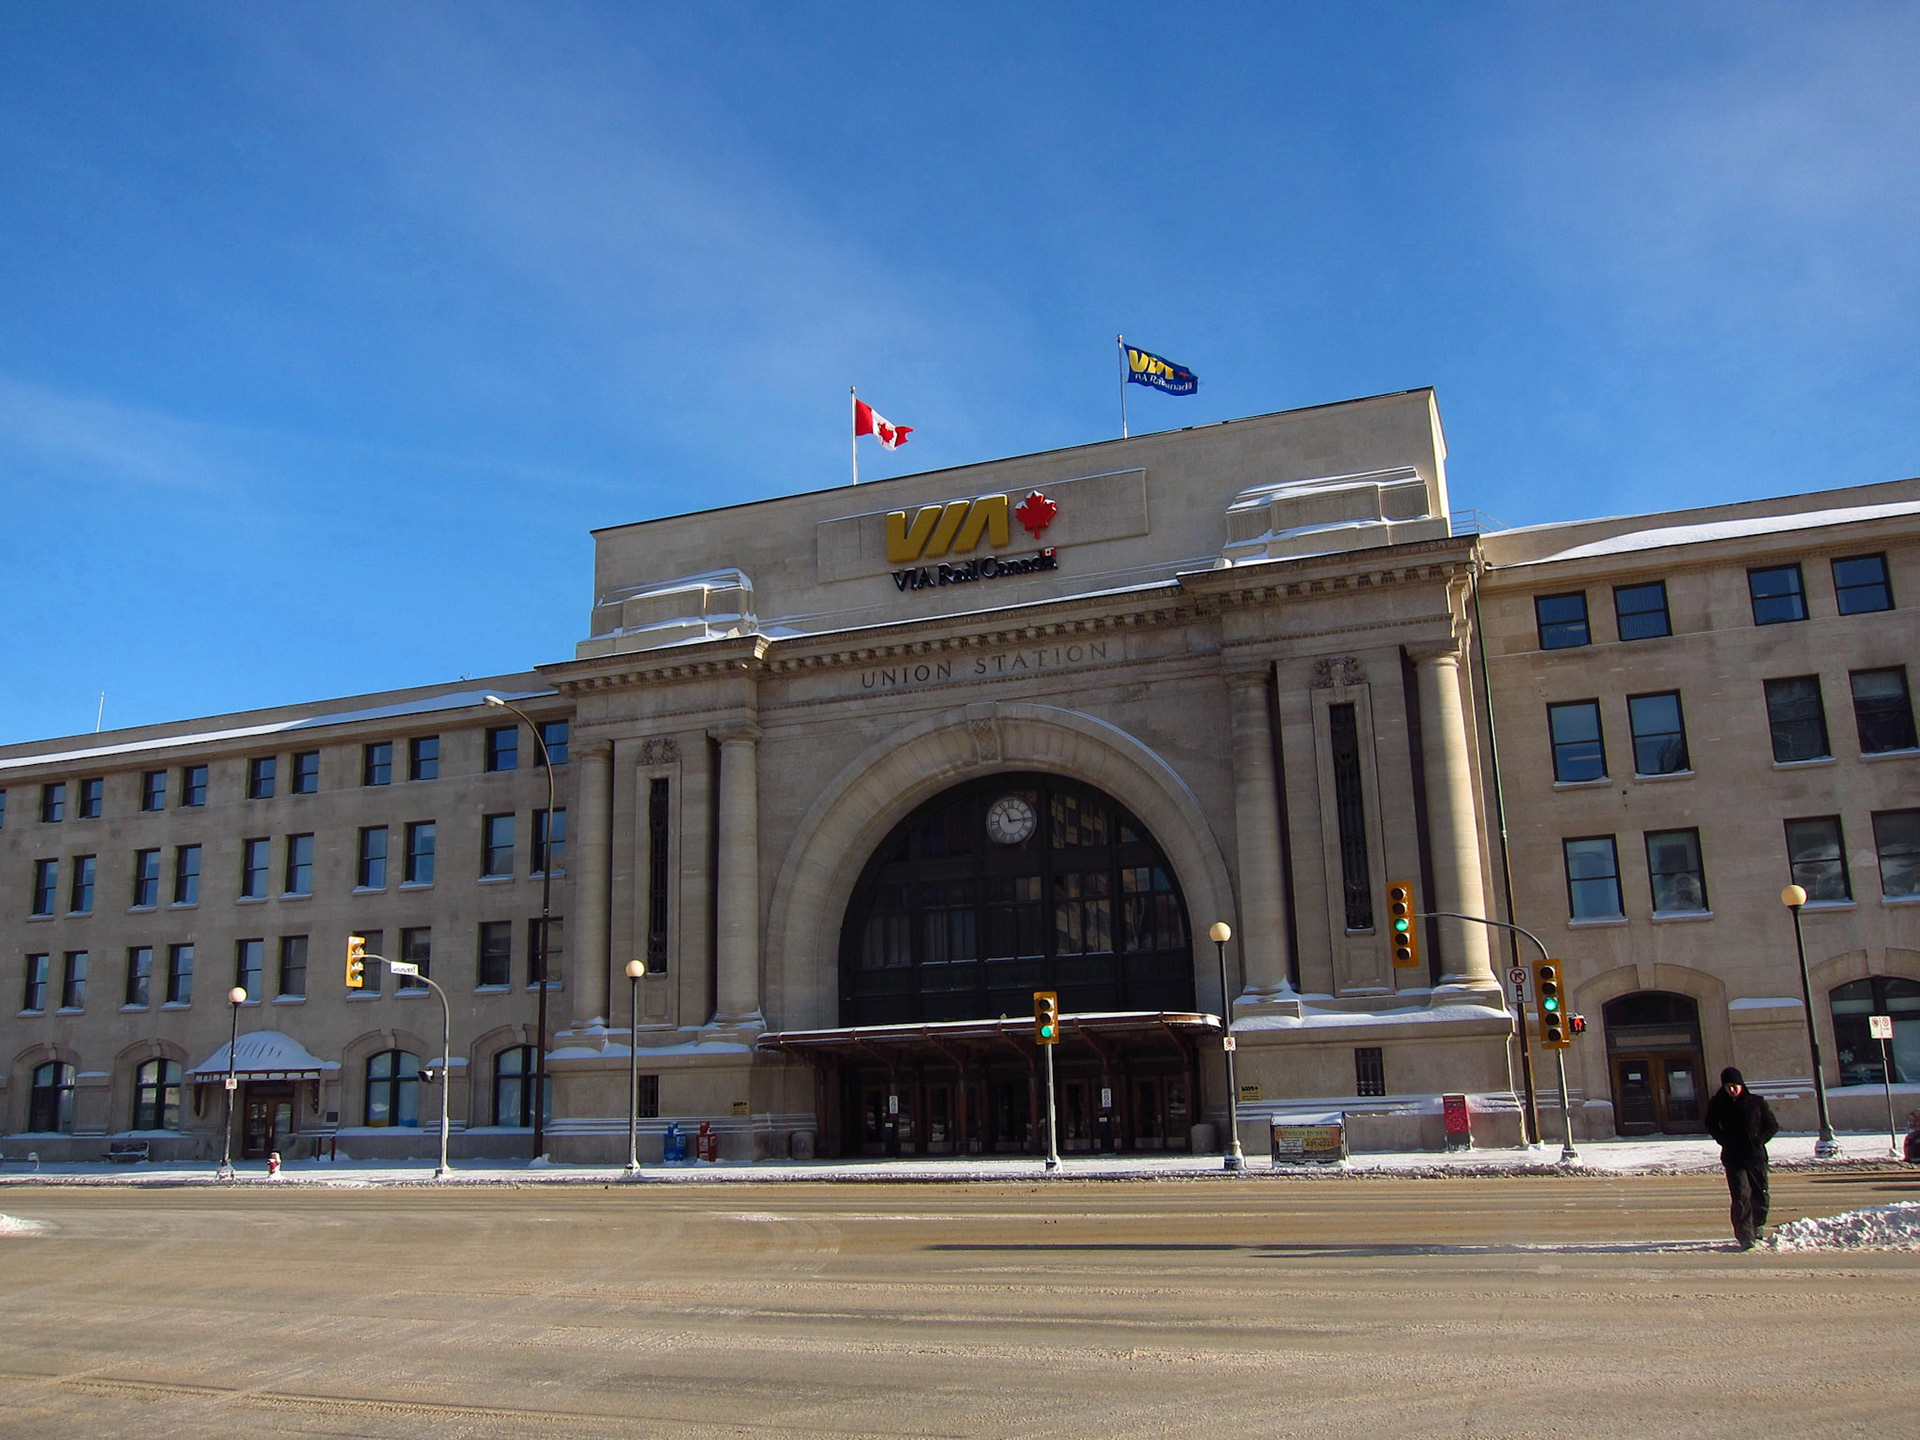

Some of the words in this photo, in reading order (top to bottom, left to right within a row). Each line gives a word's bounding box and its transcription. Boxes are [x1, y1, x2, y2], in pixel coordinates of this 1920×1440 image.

[886, 494, 1009, 563] VIA
[891, 567, 936, 592] VIA
[938, 559, 979, 586] Rail
[980, 555, 1059, 580] Canada
[861, 661, 952, 689] UNION
[974, 641, 1107, 675] STATION
